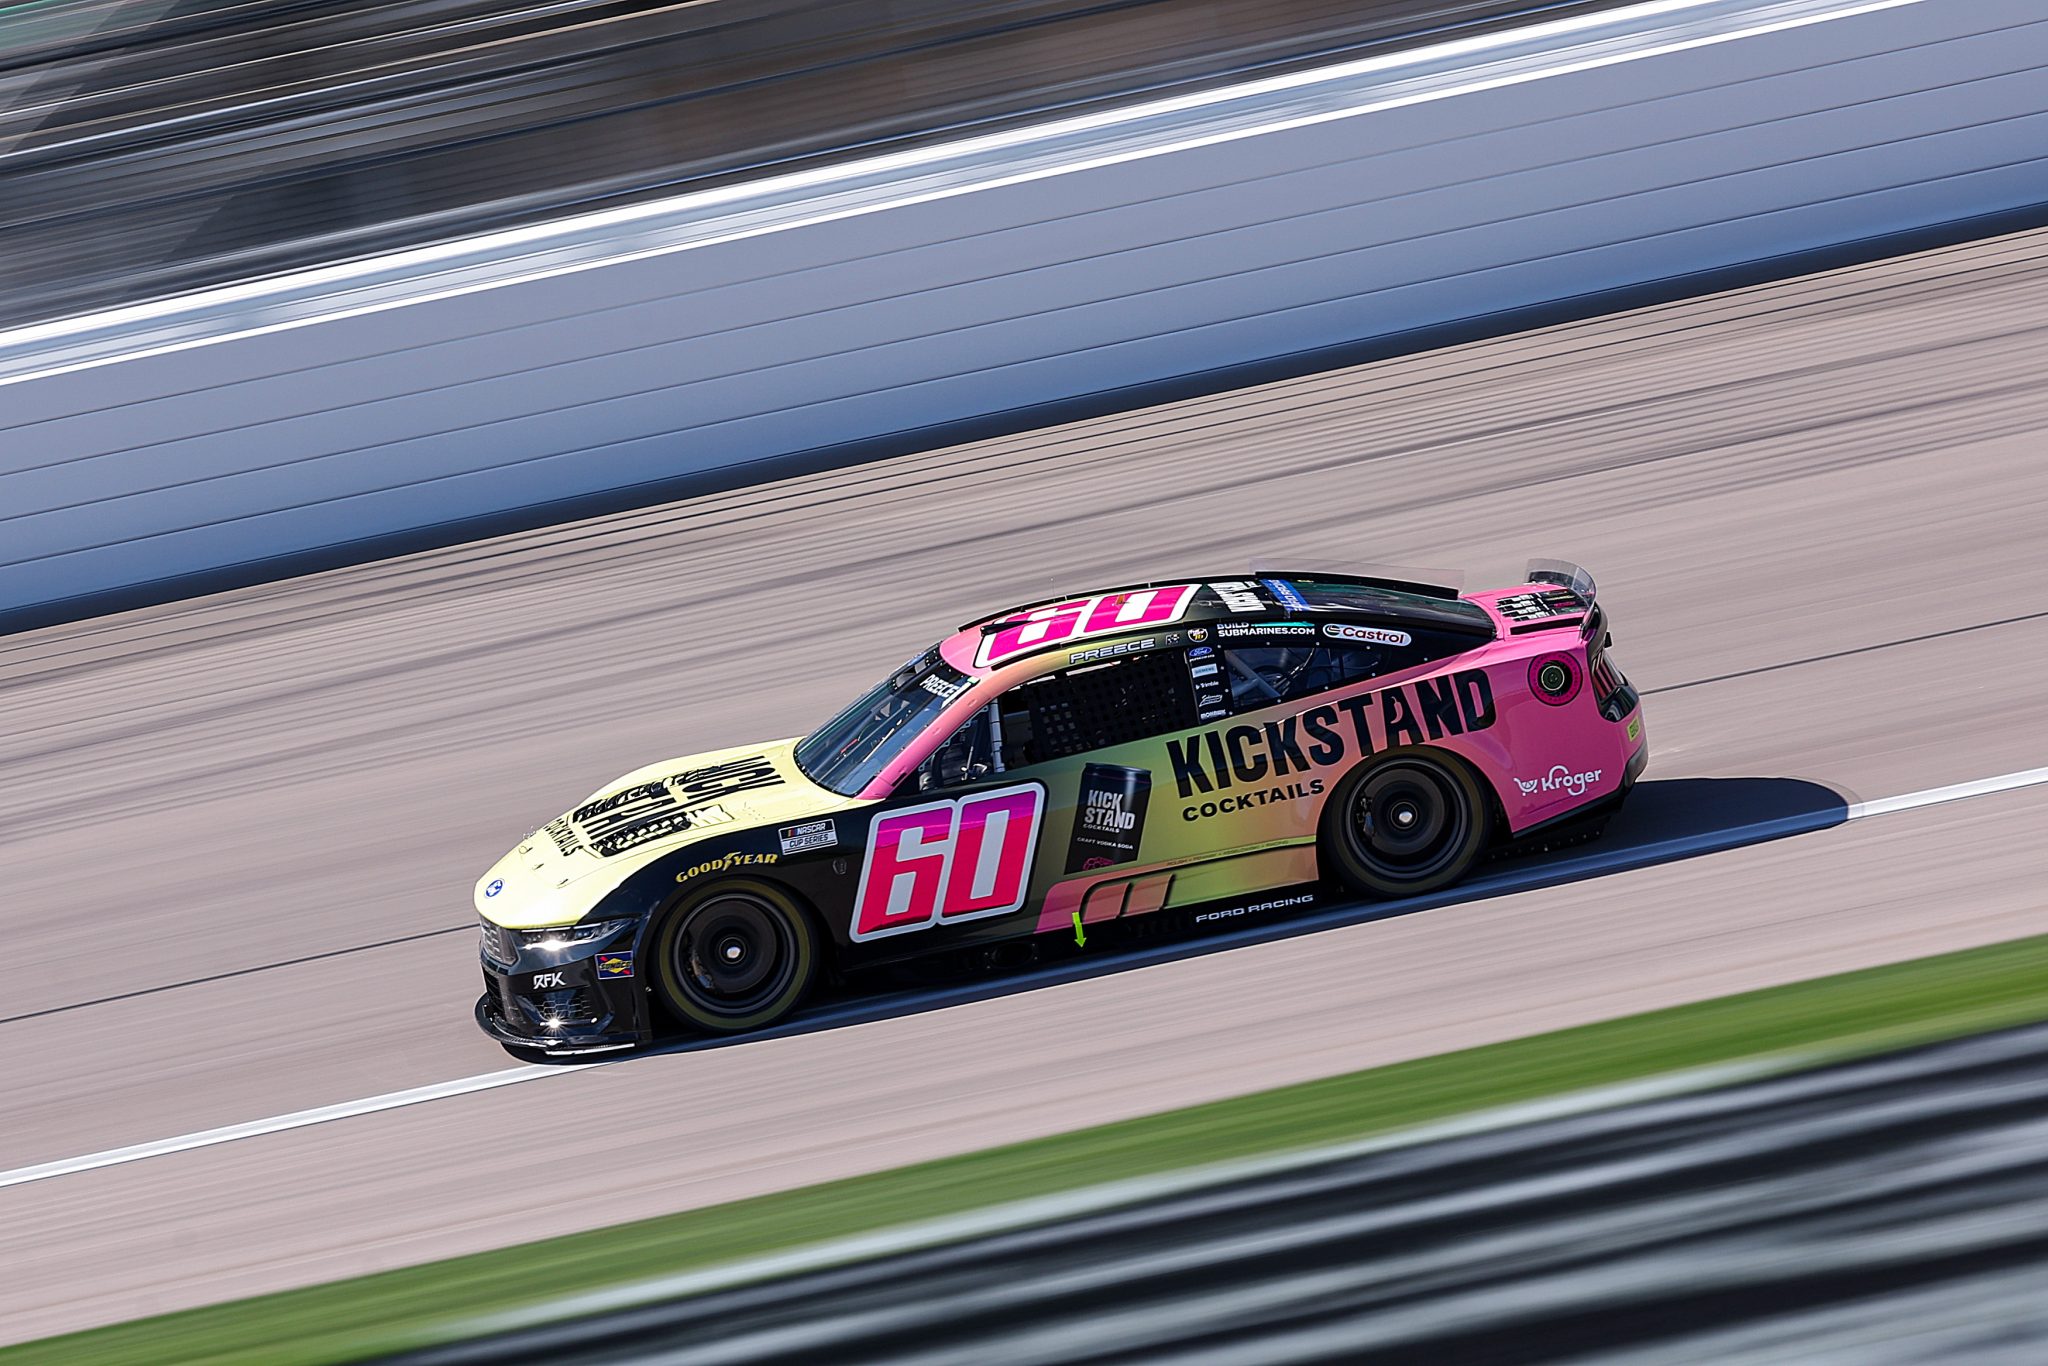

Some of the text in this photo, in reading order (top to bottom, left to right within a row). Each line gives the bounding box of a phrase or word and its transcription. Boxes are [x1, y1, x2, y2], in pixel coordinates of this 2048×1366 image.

[1218, 628, 1315, 638] SUBMARINES.COM
[1343, 627, 1404, 643] Castrol
[1070, 638, 1155, 663] PREECE
[919, 674, 961, 698] PREECE
[1166, 668, 1497, 798] KICKSTAND
[1541, 765, 1602, 796] Kroger
[1088, 790, 1123, 810] KICK
[1182, 779, 1325, 822] COCKTAILS
[797, 822, 826, 834] NASCAR
[1083, 823, 1120, 834] COCKTAILS
[1084, 807, 1136, 830] STAND
[789, 833, 829, 848] CUP SERIES
[1077, 837, 1095, 845] CRAFT
[675, 851, 778, 883] GOODYEAR
[850, 783, 1045, 942] 60
[1195, 894, 1314, 923] FORD RACING
[533, 972, 566, 990] RFK
